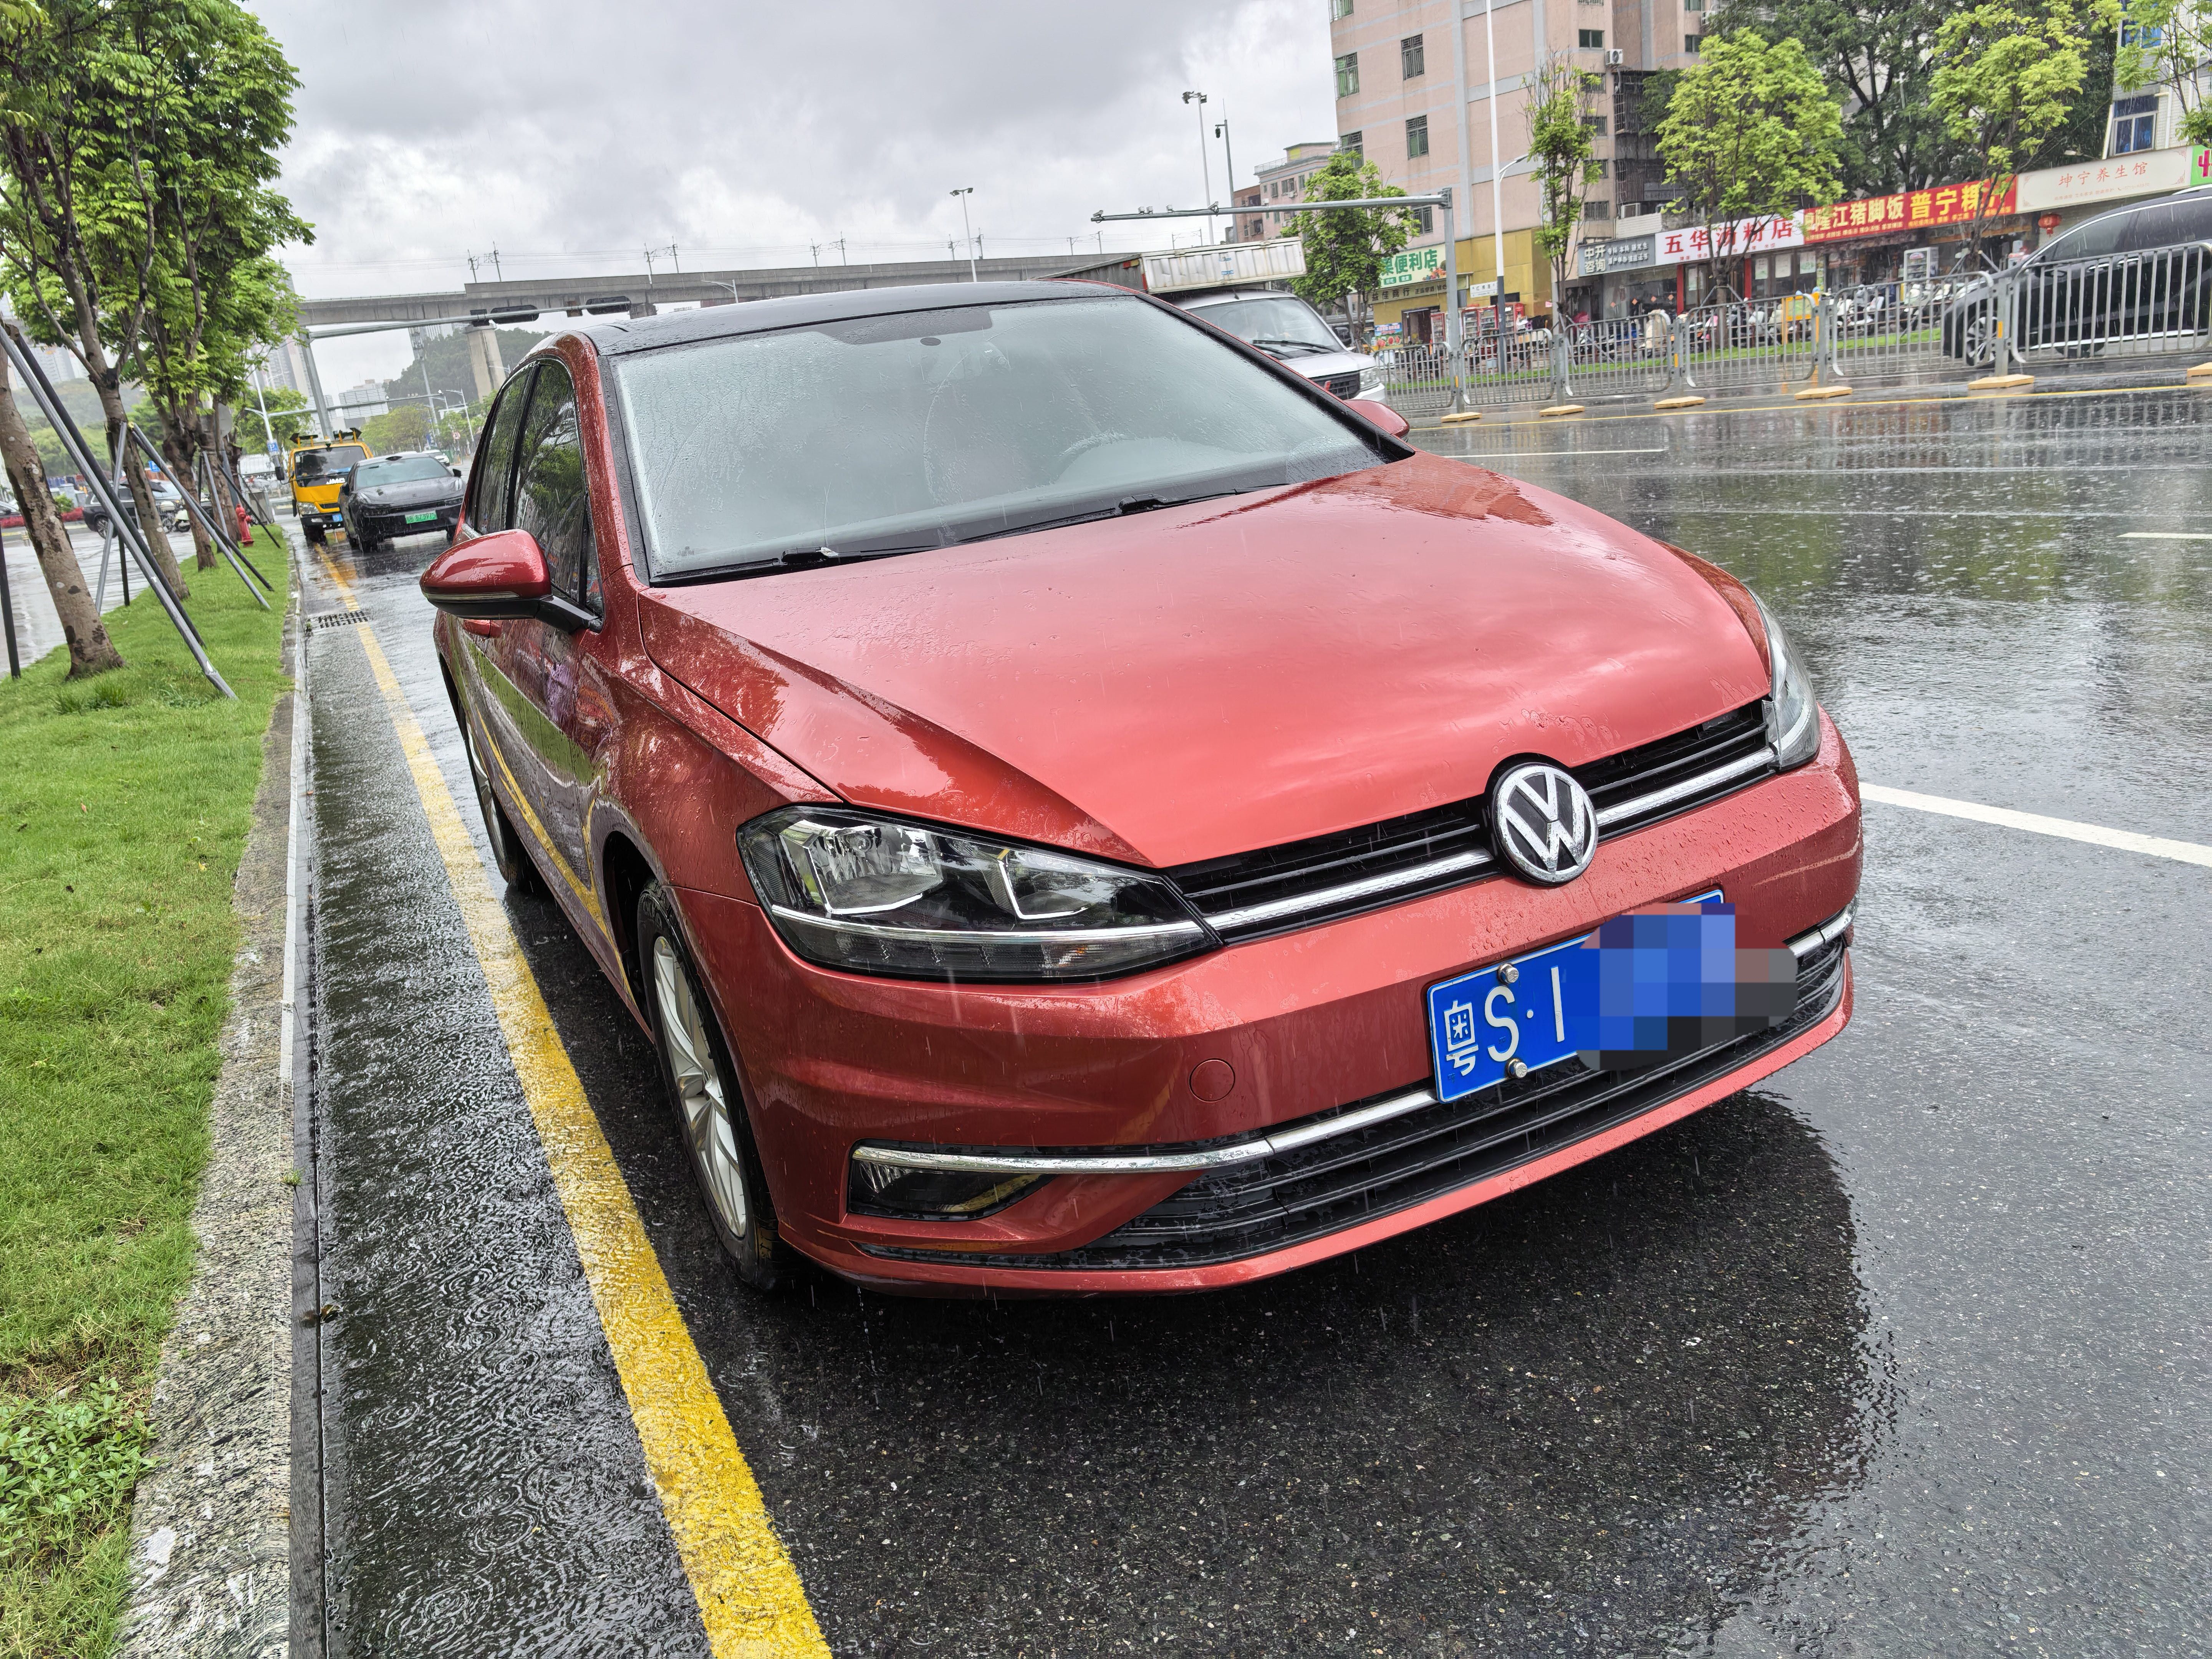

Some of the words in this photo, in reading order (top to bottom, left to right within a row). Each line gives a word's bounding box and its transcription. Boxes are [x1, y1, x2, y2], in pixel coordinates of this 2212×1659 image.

[2058, 162, 2148, 188] 坤宁养生馆
[1664, 217, 1793, 254] 五华汤粉店
[1584, 245, 1606, 260] 中开
[1584, 258, 1605, 273] 咨询
